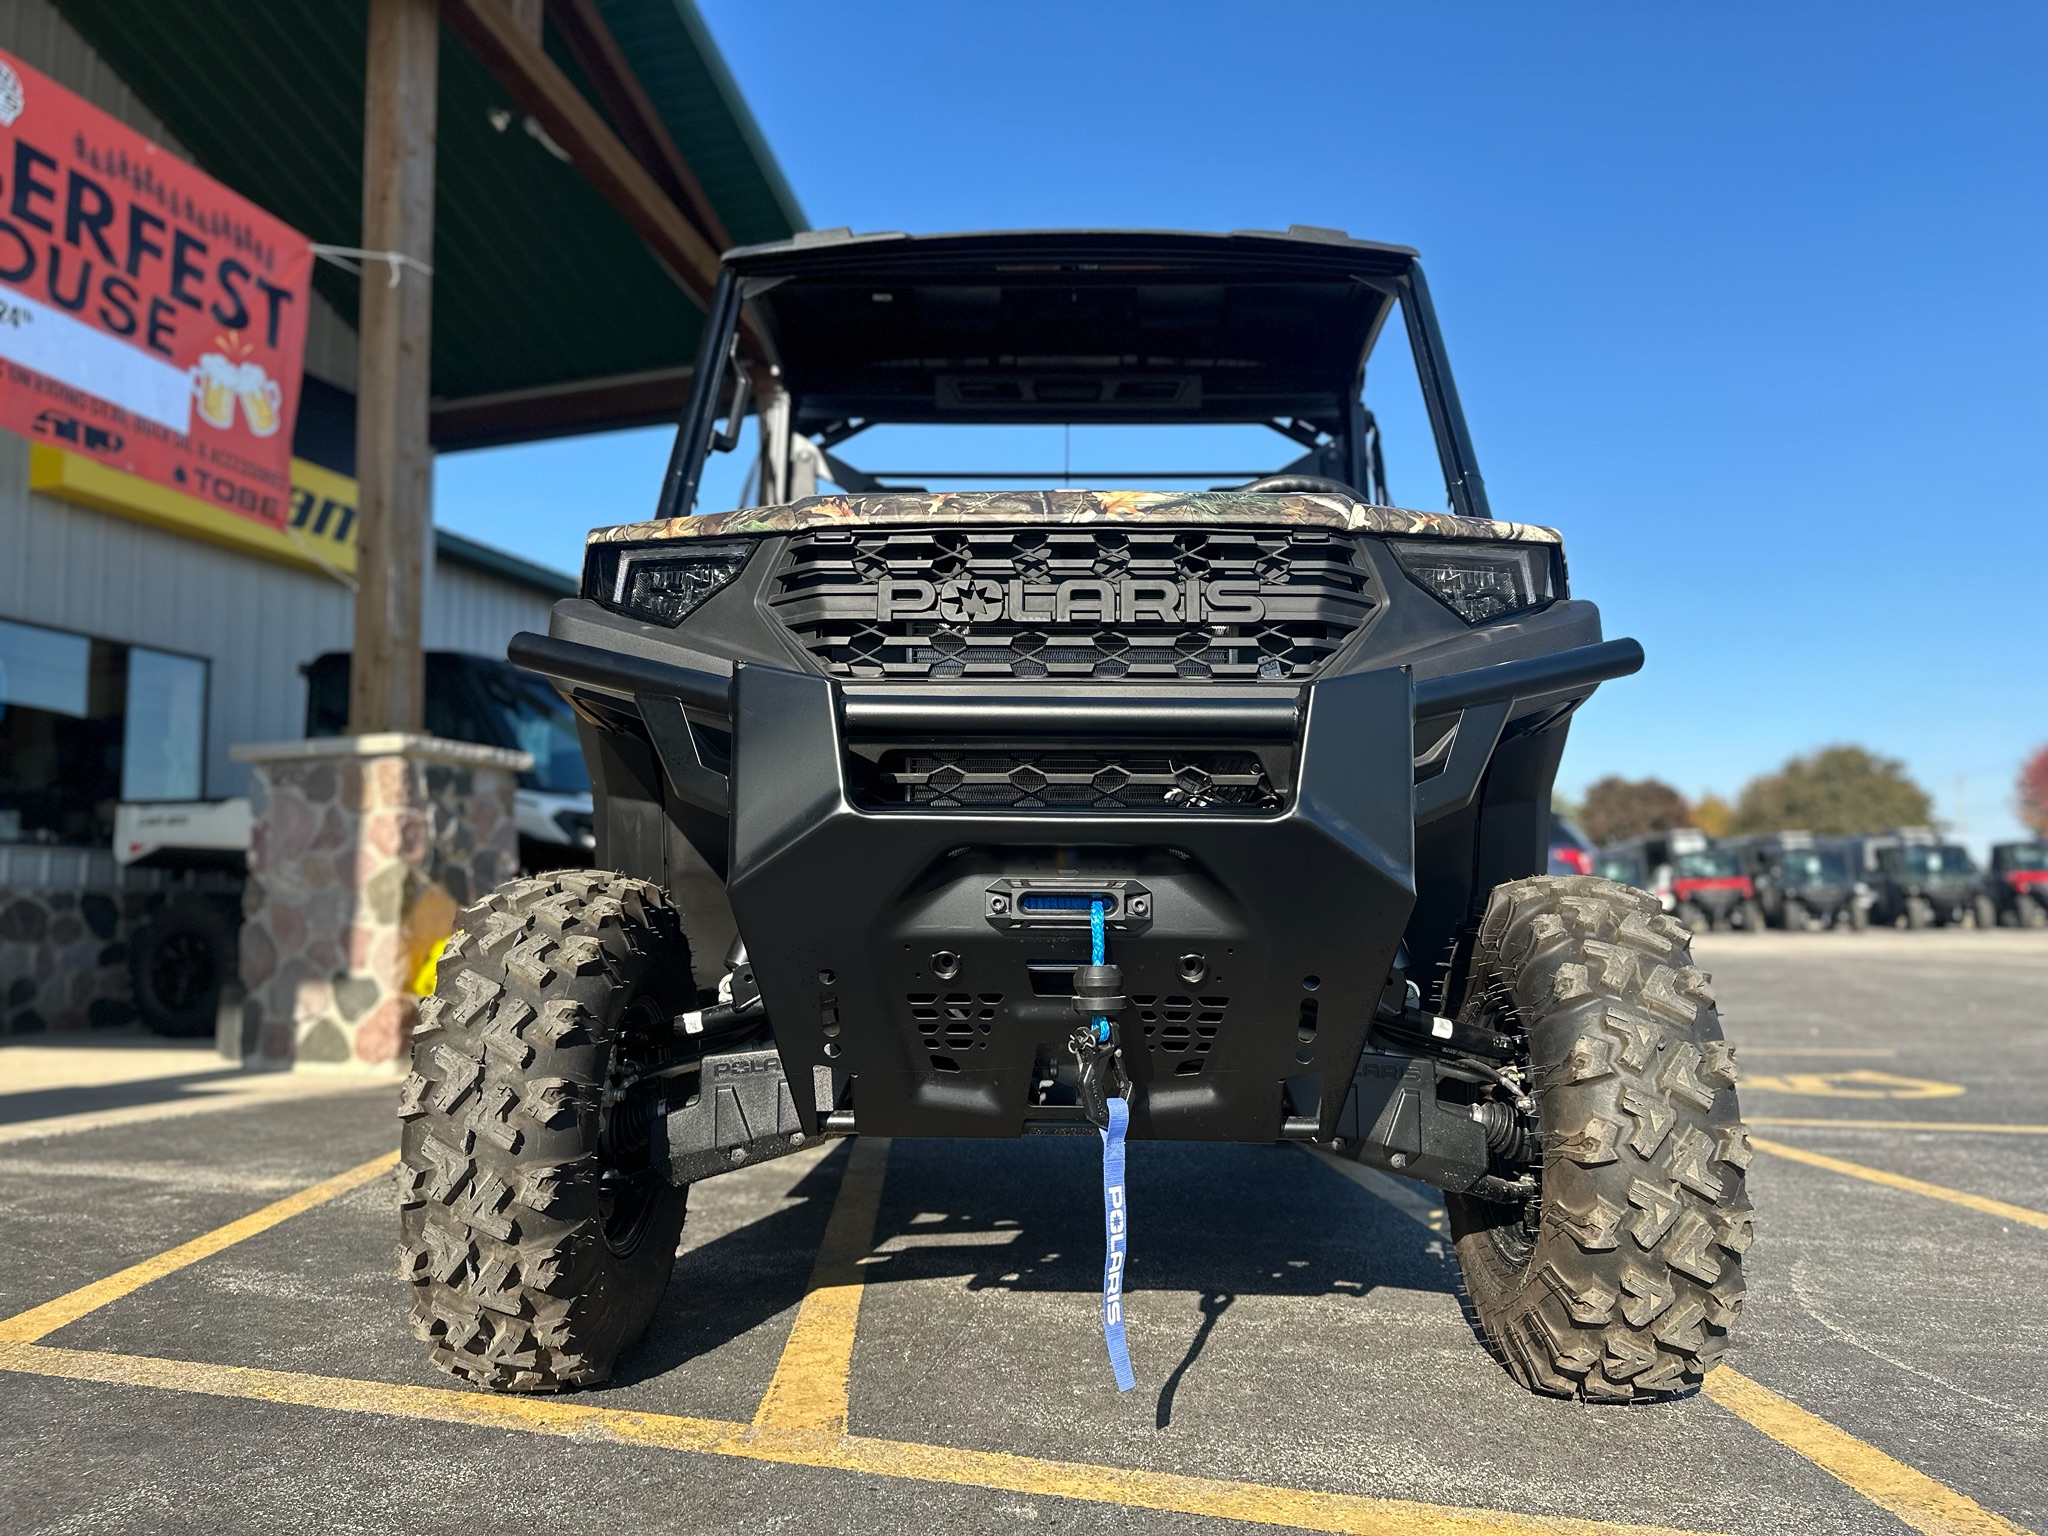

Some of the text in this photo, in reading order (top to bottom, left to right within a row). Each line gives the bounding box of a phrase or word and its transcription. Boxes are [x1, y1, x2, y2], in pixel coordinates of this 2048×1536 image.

[0, 138, 293, 349] ERFEST
[877, 579, 1265, 623] POLARIS
[1106, 1185, 1125, 1326] POLARIS
